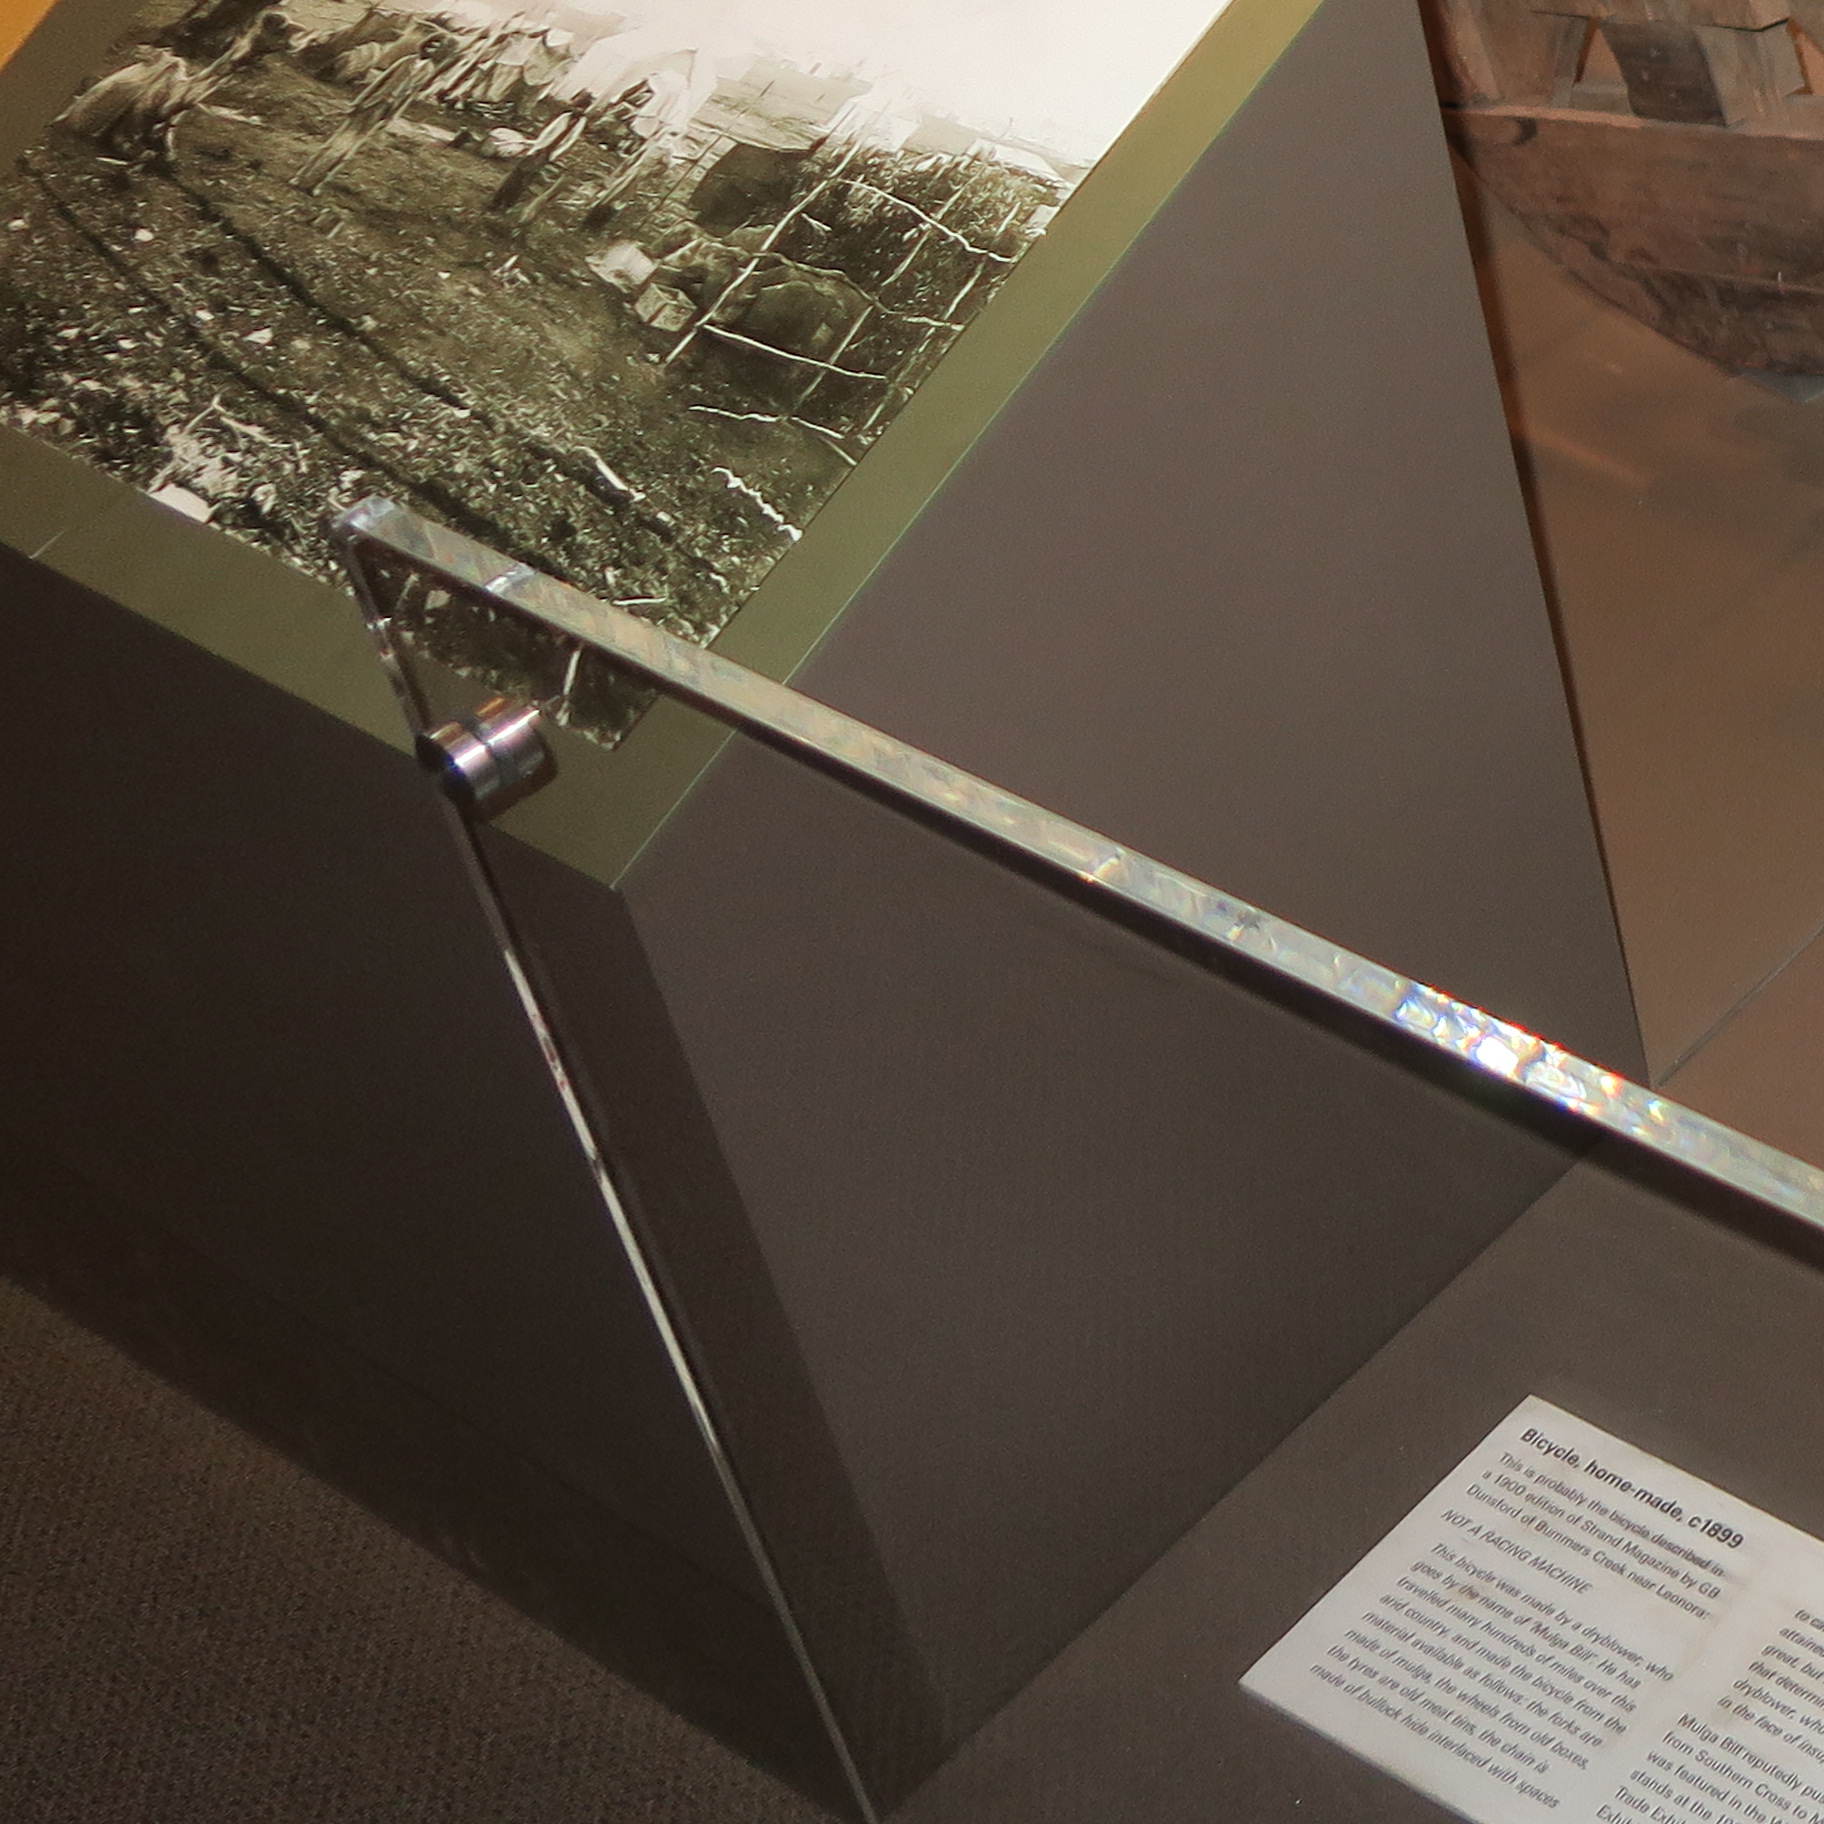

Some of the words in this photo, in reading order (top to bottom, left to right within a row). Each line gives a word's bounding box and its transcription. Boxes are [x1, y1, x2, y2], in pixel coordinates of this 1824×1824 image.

[1466, 1483, 1523, 1518] Dunsford
[1519, 1514, 1537, 1526] of
[1592, 1550, 1626, 1575] Creek
[1626, 1571, 1656, 1590] near
[1481, 1471, 1492, 1479] a
[1493, 1473, 1526, 1496] 1900
[1524, 1493, 1565, 1517] edition
[1565, 1513, 1583, 1525] of
[1580, 1519, 1624, 1547] Strand
[1621, 1540, 1679, 1578] Magazine
[1679, 1571, 1698, 1589] by
[1697, 1581, 1721, 1599] GB
[1499, 1451, 1523, 1471] This
[1522, 1467, 1535, 1478] is
[1533, 1474, 1587, 1506] probably
[1586, 1499, 1609, 1516] the
[1608, 1509, 1650, 1539] bicycle
[1650, 1533, 1712, 1569] described
[1709, 1562, 1724, 1577] in
[1520, 1427, 1579, 1468] Bicycle,
[1583, 1459, 1682, 1522] home-made,
[1687, 1515, 1744, 1549] c1899
[1440, 1509, 1472, 1528] NOT
[1466, 1524, 1483, 1536] A
[1479, 1530, 1531, 1561] RACING
[1527, 1556, 1592, 1593] MACHINE
[1379, 1594, 1410, 1611] arid
[1451, 1633, 1480, 1650] and
[1475, 1646, 1511, 1669] made
[1509, 1664, 1532, 1681] the
[1530, 1675, 1574, 1704] bicycle
[1572, 1699, 1605, 1721] from
[1603, 1716, 1626, 1734] the
[1397, 1576, 1450, 1607] travelled
[1445, 1604, 1481, 1627] many
[1479, 1621, 1536, 1656] hundreds
[1534, 1653, 1555, 1664] of
[1548, 1661, 1584, 1683] miles
[1583, 1680, 1612, 1698] over
[1610, 1694, 1636, 1712] this
[1410, 1561, 1442, 1579] goes
[1441, 1574, 1459, 1590] by
[1457, 1584, 1479, 1599] the
[1477, 1596, 1513, 1618] name
[1512, 1615, 1532, 1625] of
[1595, 1658, 1617, 1675] He
[1615, 1669, 1641, 1689] has
[1430, 1542, 1456, 1561] This
[1454, 1556, 1496, 1582] bicycle
[1495, 1579, 1521, 1597] was
[1520, 1593, 1555, 1615] made
[1554, 1609, 1572, 1626] by
[1570, 1622, 1582, 1631] a
[1645, 1661, 1674, 1681] who
[1794, 1608, 1810, 1621] to
[1326, 1644, 1349, 1662] the
[1347, 1657, 1379, 1678] tyres
[1377, 1676, 1400, 1690] are
[1398, 1687, 1425, 1702] old
[1419, 1698, 1454, 1720] meat
[1477, 1729, 1501, 1747] the
[1500, 1743, 1535, 1766] chain
[1533, 1759, 1549, 1774] is
[1343, 1629, 1380, 1652] made
[1378, 1648, 1399, 1659] of
[1434, 1676, 1457, 1694] the
[1456, 1690, 1500, 1717] wheels
[1498, 1711, 1531, 1735] from
[1529, 1731, 1556, 1746] old
[1361, 1612, 1416, 1642] material
[1410, 1638, 1463, 1669] available
[1462, 1667, 1480, 1679] as
[1525, 1700, 1548, 1717] the
[1547, 1711, 1580, 1734] forks
[1578, 1731, 1603, 1746] are
[1716, 1695, 1733, 1709] in
[1731, 1703, 1755, 1721] the
[1754, 1715, 1783, 1735] face
[1782, 1733, 1802, 1744] of
[1748, 1660, 1777, 1680] that
[1799, 1661, 1824, 1680] but
[1309, 1664, 1345, 1687] made
[1342, 1684, 1364, 1695] of
[1357, 1689, 1402, 1719] bullock
[1399, 1713, 1429, 1735] hide
[1427, 1732, 1492, 1767] interlaced
[1487, 1763, 1518, 1784] with
[1516, 1780, 1559, 1808] spaces
[1646, 1751, 1673, 1771] was
[1673, 1764, 1730, 1801] featured
[1727, 1794, 1742, 1810] in
[1743, 1803, 1766, 1821] the
[1662, 1730, 1693, 1755] from
[1694, 1749, 1753, 1789] Southern
[1754, 1783, 1791, 1810] Cross
[1792, 1804, 1807, 1819] to
[1676, 1713, 1719, 1743] Mulga
[1741, 1751, 1802, 1790] reputedly
[1614, 1785, 1650, 1813] Trade
[1629, 1770, 1673, 1799] stands
[1672, 1794, 1690, 1807] at
[1688, 1800, 1712, 1819] the
